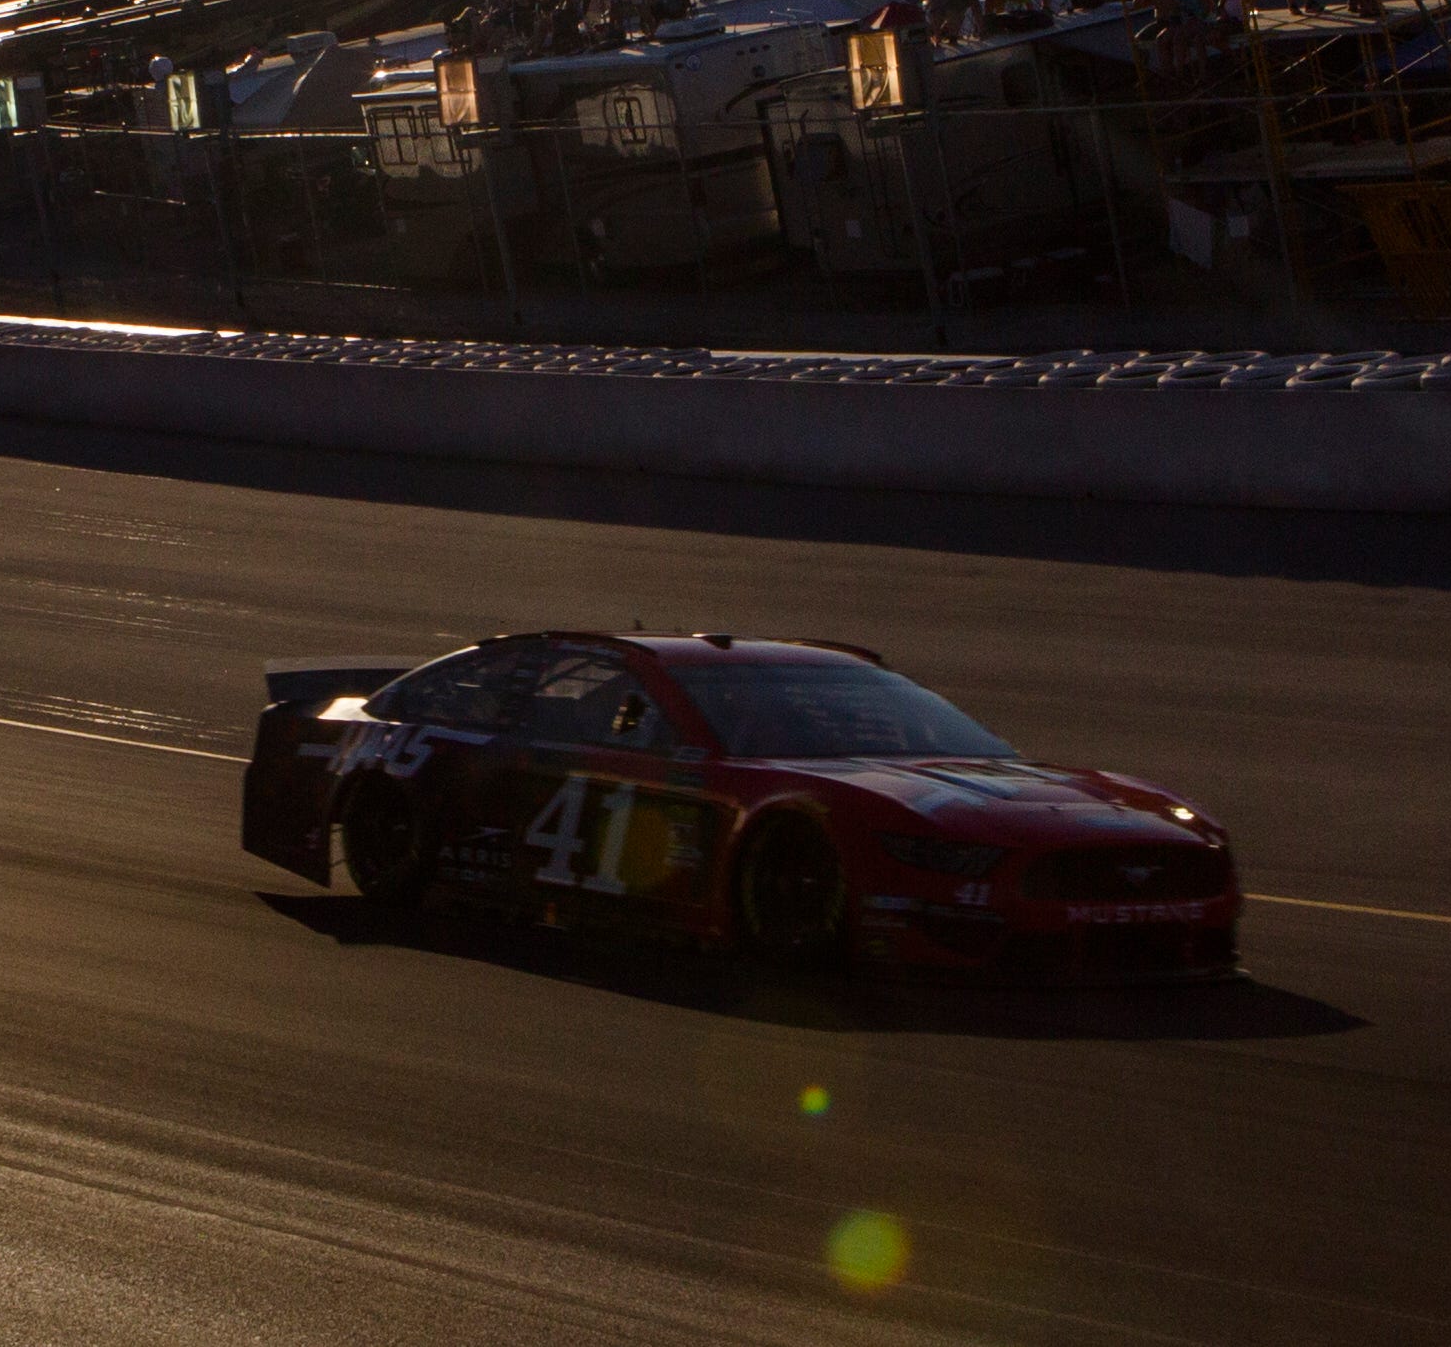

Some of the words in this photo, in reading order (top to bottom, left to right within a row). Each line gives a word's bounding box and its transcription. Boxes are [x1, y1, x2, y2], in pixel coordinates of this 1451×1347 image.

[524, 772, 635, 894] 41
[953, 882, 991, 906] 41
[1066, 902, 1207, 924] MUSTANG
